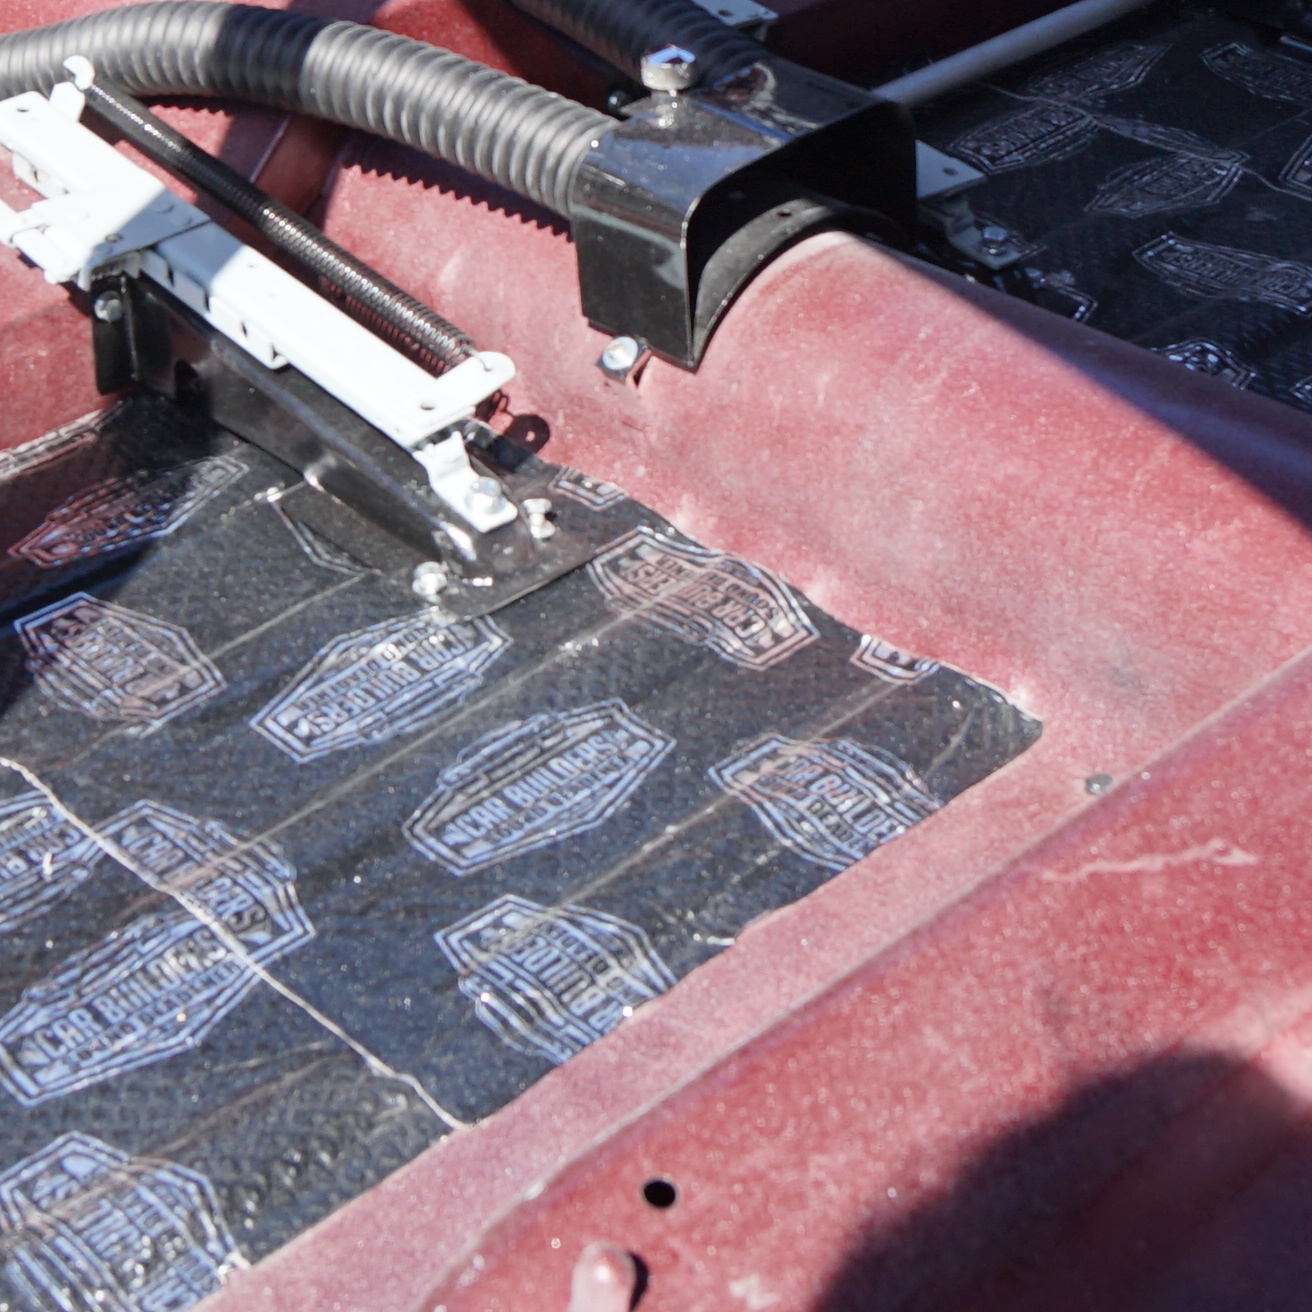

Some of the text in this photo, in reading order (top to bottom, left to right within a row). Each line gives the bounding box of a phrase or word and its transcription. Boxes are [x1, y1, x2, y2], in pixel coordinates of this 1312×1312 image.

[709, 597, 767, 639] CAR
[307, 627, 468, 736] CAR BUILDERS
[461, 730, 619, 840] CAR BUILDERS
[34, 929, 228, 1059] CAR BUILDERS
[496, 931, 606, 1017] BUILDE
